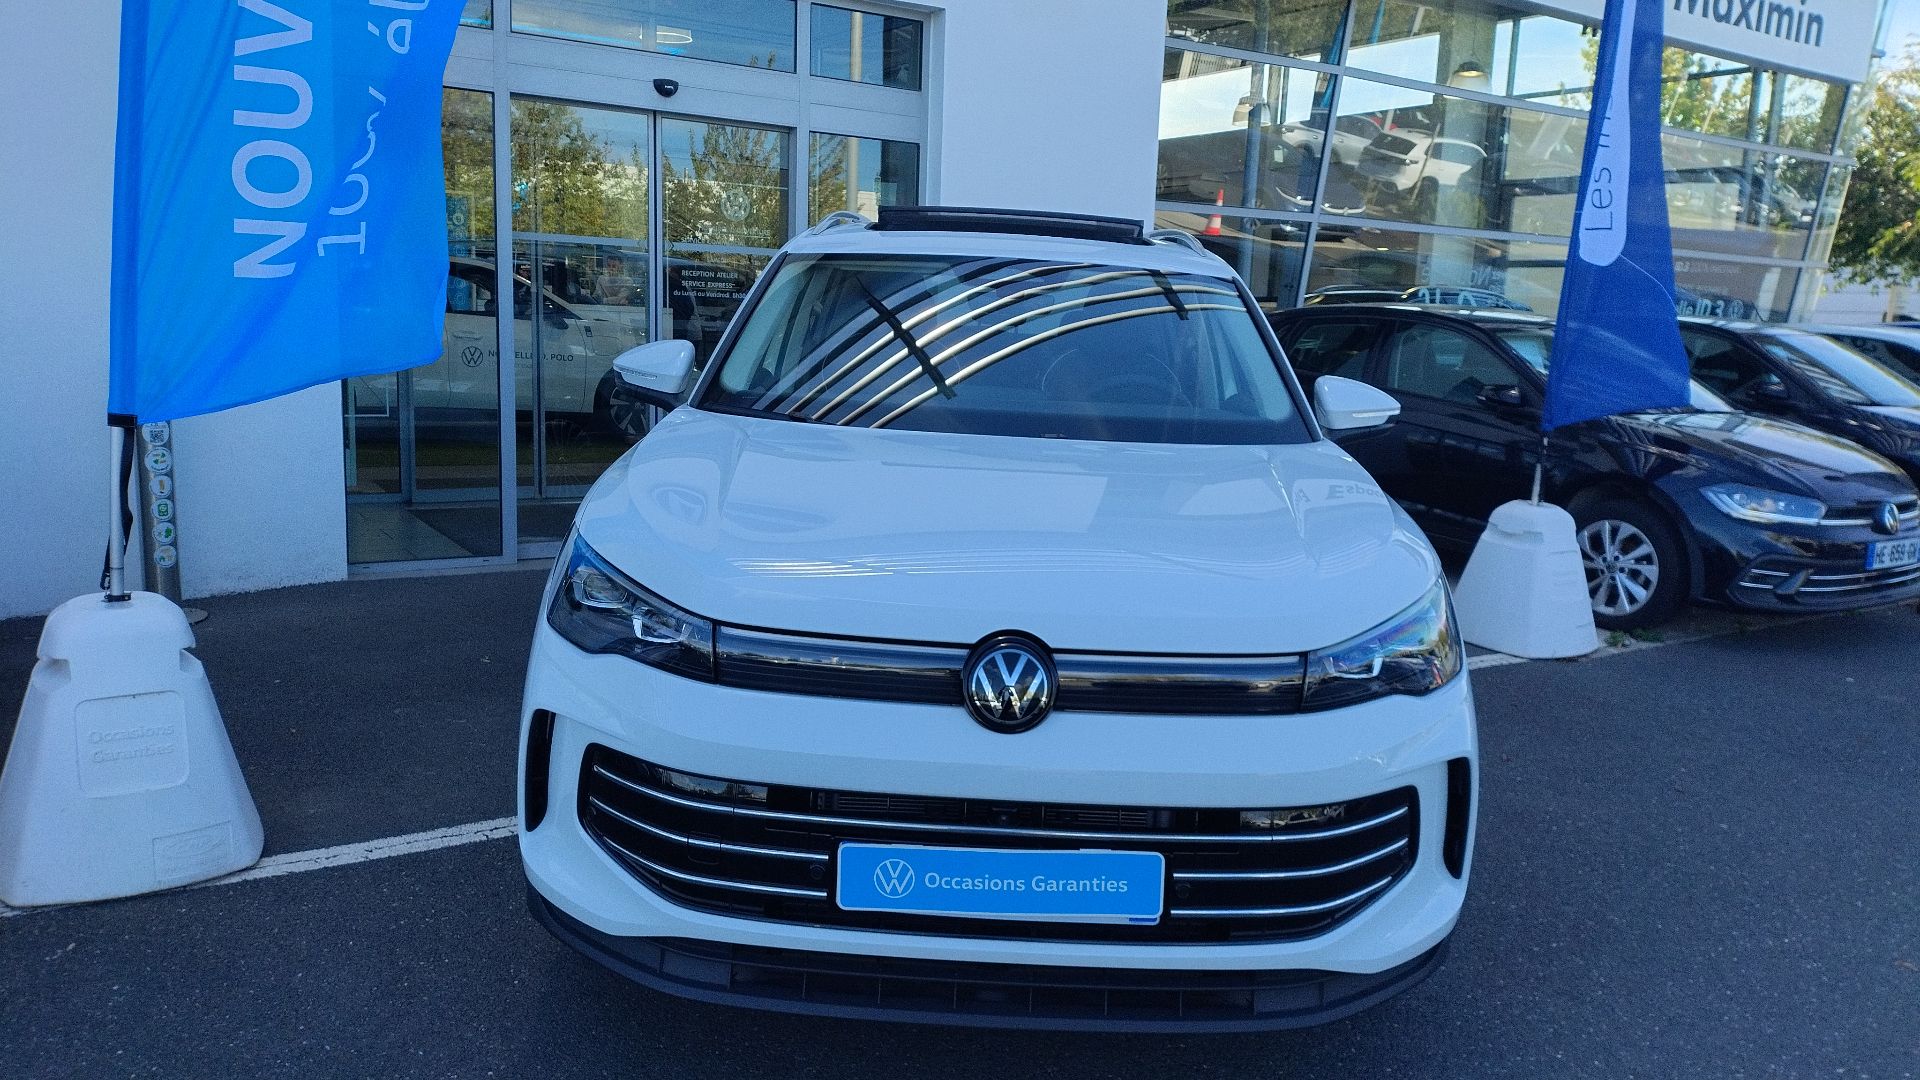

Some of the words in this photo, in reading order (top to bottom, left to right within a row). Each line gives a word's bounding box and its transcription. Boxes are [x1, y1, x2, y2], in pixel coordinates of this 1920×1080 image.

[232, 0, 313, 279] NOUV
[1585, 166, 1613, 231] Les
[681, 269, 715, 278] RECEPTION
[716, 271, 738, 279] ATELIER
[550, 353, 574, 362] POLO
[924, 872, 1026, 892] Occasions
[1031, 875, 1128, 893] Garanties
